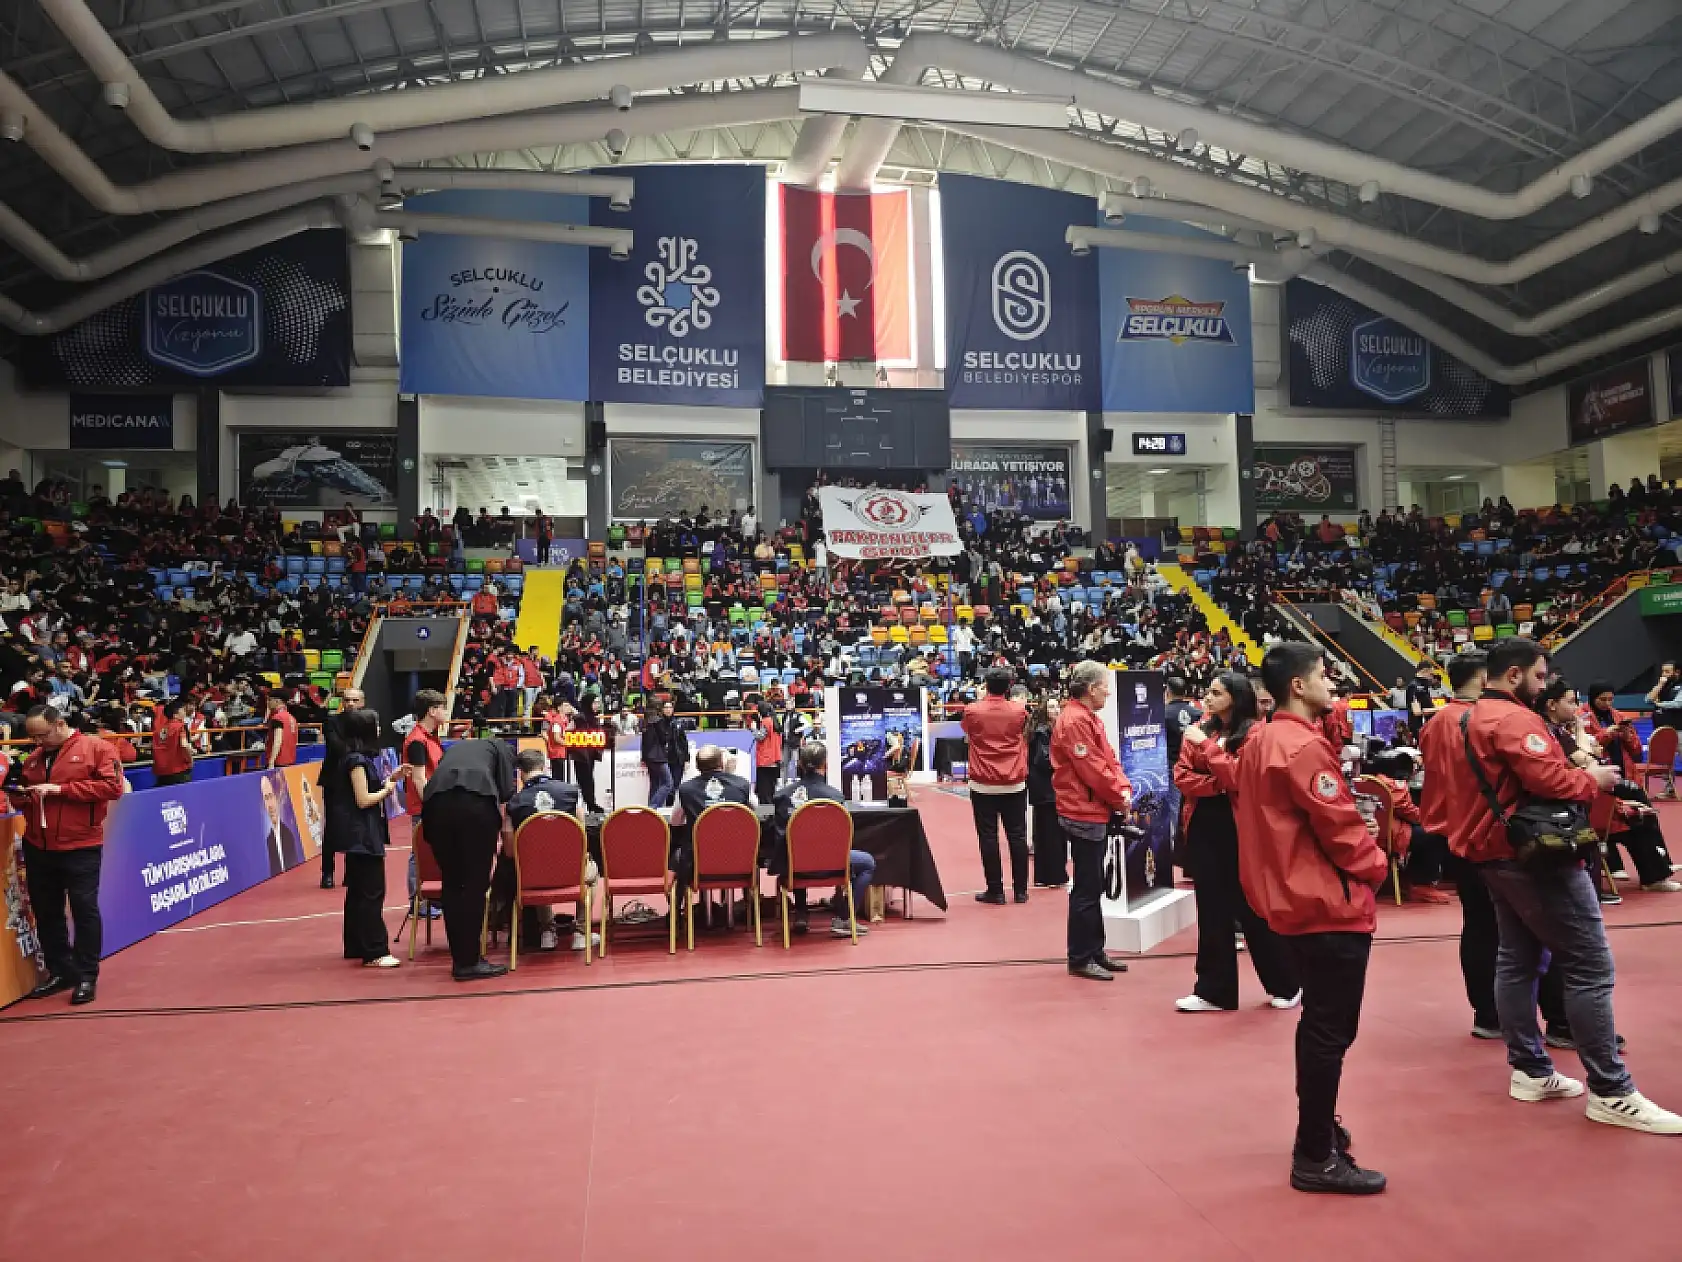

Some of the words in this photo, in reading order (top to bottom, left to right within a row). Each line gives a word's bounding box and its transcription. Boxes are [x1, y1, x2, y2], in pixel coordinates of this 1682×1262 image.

[450, 268, 543, 291] SELÇUKLU
[157, 294, 247, 320] SELÇUKLU
[1128, 316, 1222, 337] SELÇUKLU
[619, 343, 738, 368] SELÇUKLU
[964, 351, 1081, 371] SELÇUKLU
[618, 366, 739, 389] BELEDİYESİ
[73, 413, 159, 428] MEDICANA
